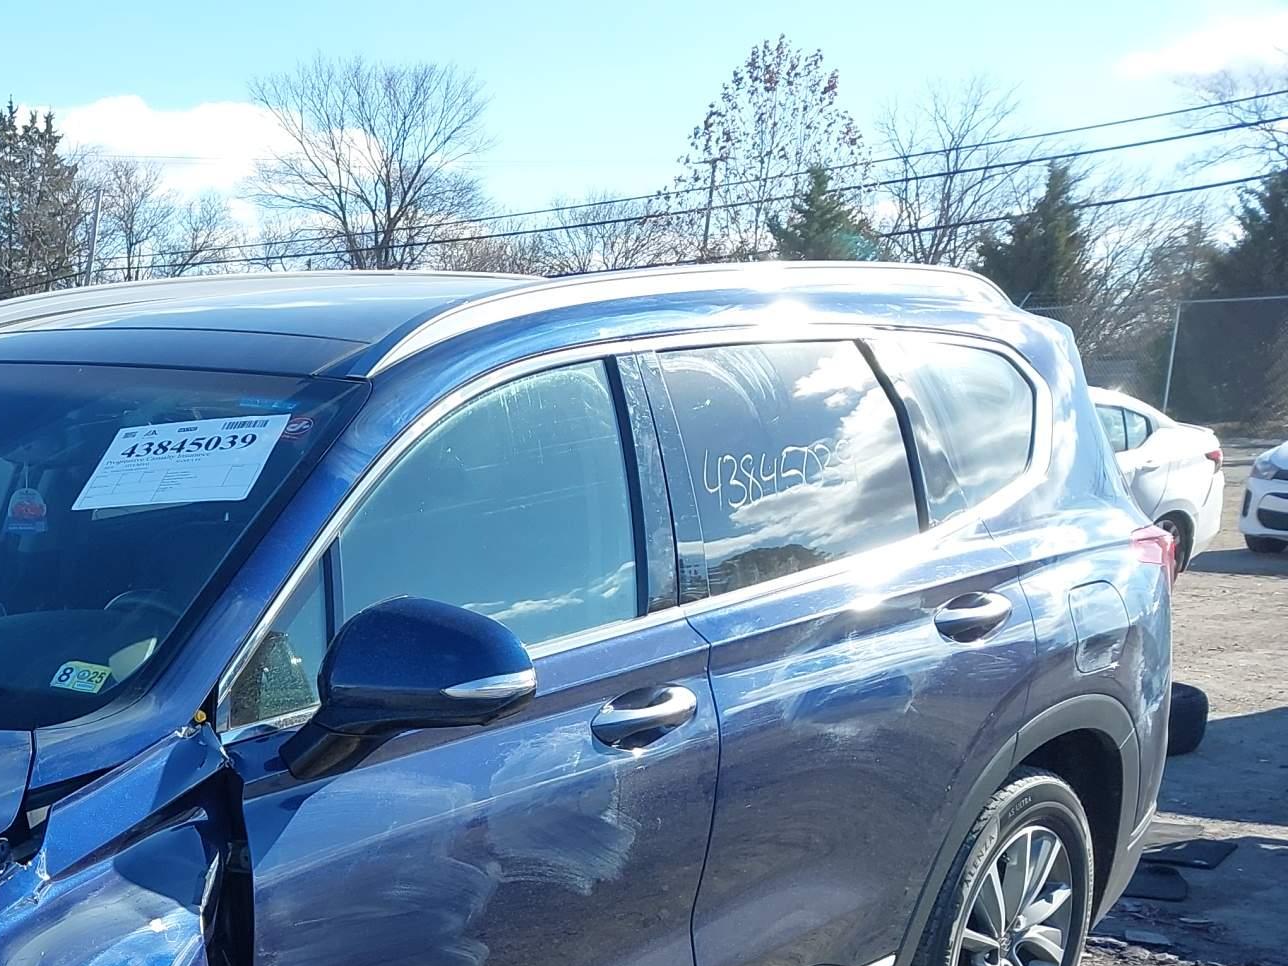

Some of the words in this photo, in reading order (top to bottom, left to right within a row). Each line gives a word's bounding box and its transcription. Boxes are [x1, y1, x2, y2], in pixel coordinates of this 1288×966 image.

[120, 433, 257, 458] 43845039
[58, 667, 74, 682] 8
[87, 671, 107, 684] 25
[963, 834, 995, 889] ALENZA
